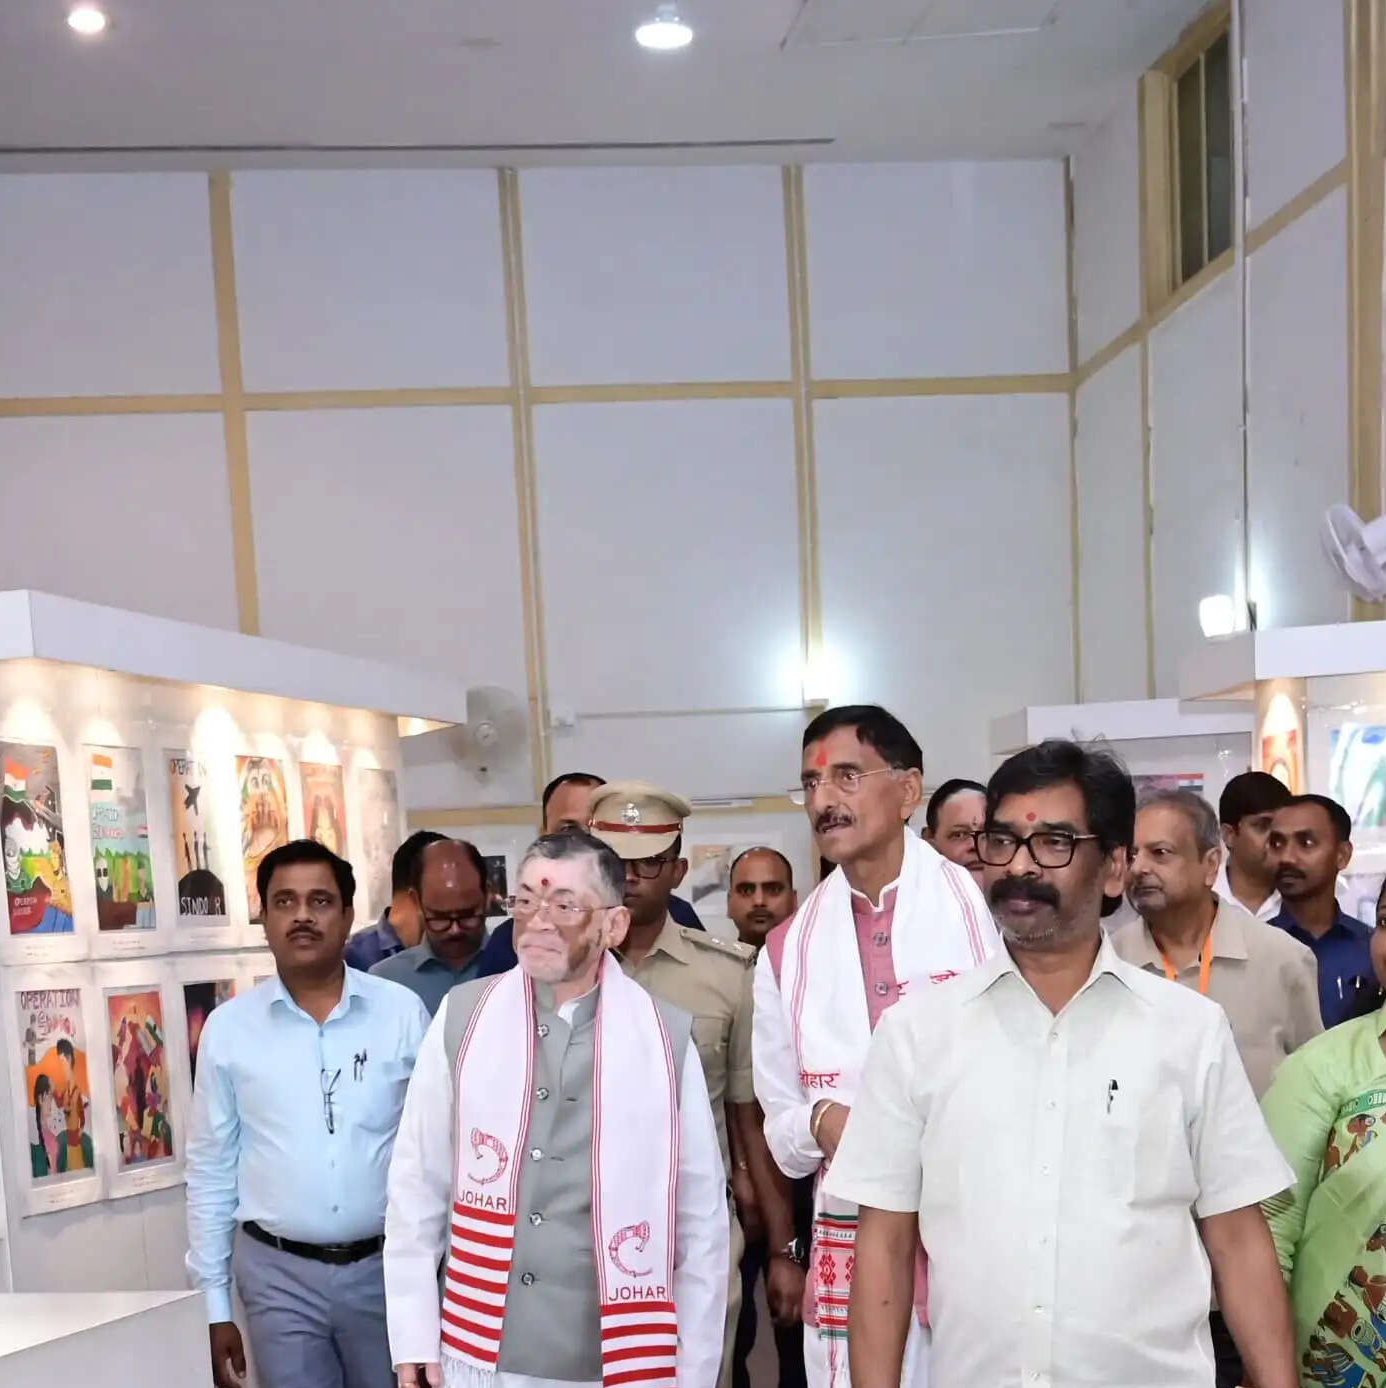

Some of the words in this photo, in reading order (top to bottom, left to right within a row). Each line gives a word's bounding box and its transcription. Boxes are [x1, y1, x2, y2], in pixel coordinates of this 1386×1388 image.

[20, 990, 80, 1010] OPERATION
[459, 1191, 508, 1212] JOHAR
[608, 1286, 667, 1302] JOHAR
